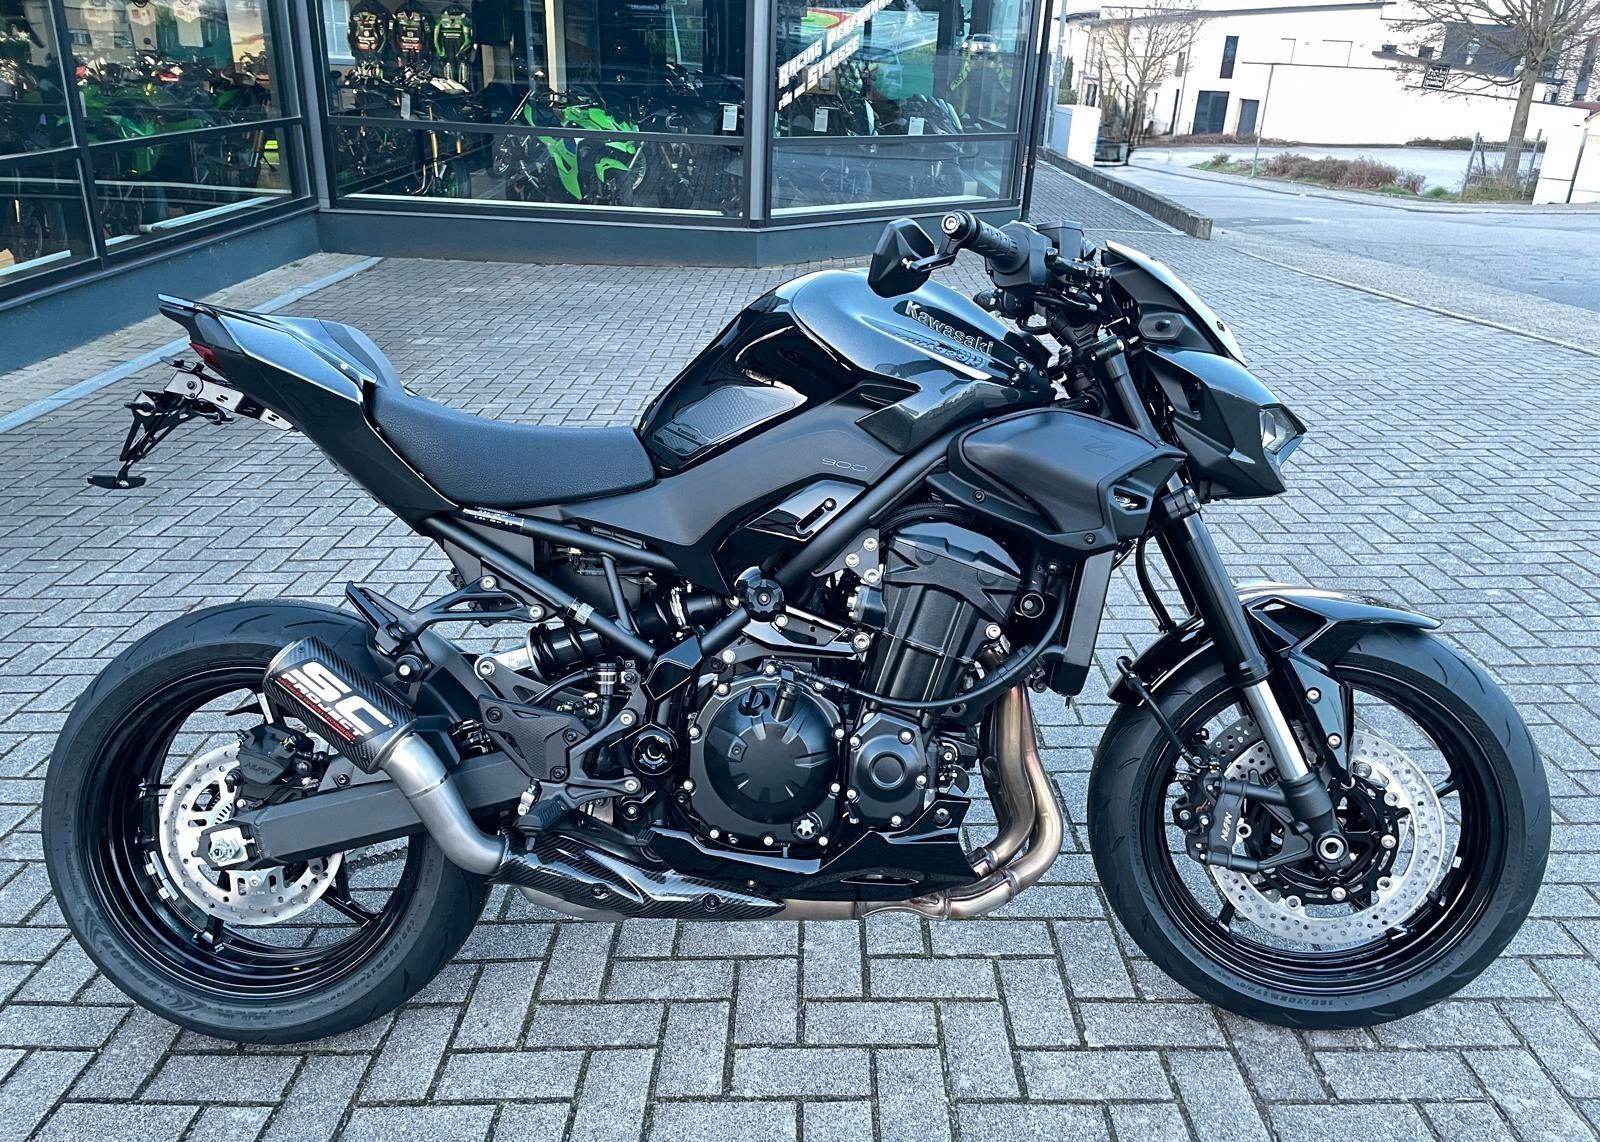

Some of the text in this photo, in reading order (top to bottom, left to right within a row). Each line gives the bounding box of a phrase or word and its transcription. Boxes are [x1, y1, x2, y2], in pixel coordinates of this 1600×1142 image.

[904, 299, 995, 357] Kawasaki
[822, 457, 868, 472] 900
[279, 671, 367, 738] PROJECT
[289, 661, 393, 735] SC
